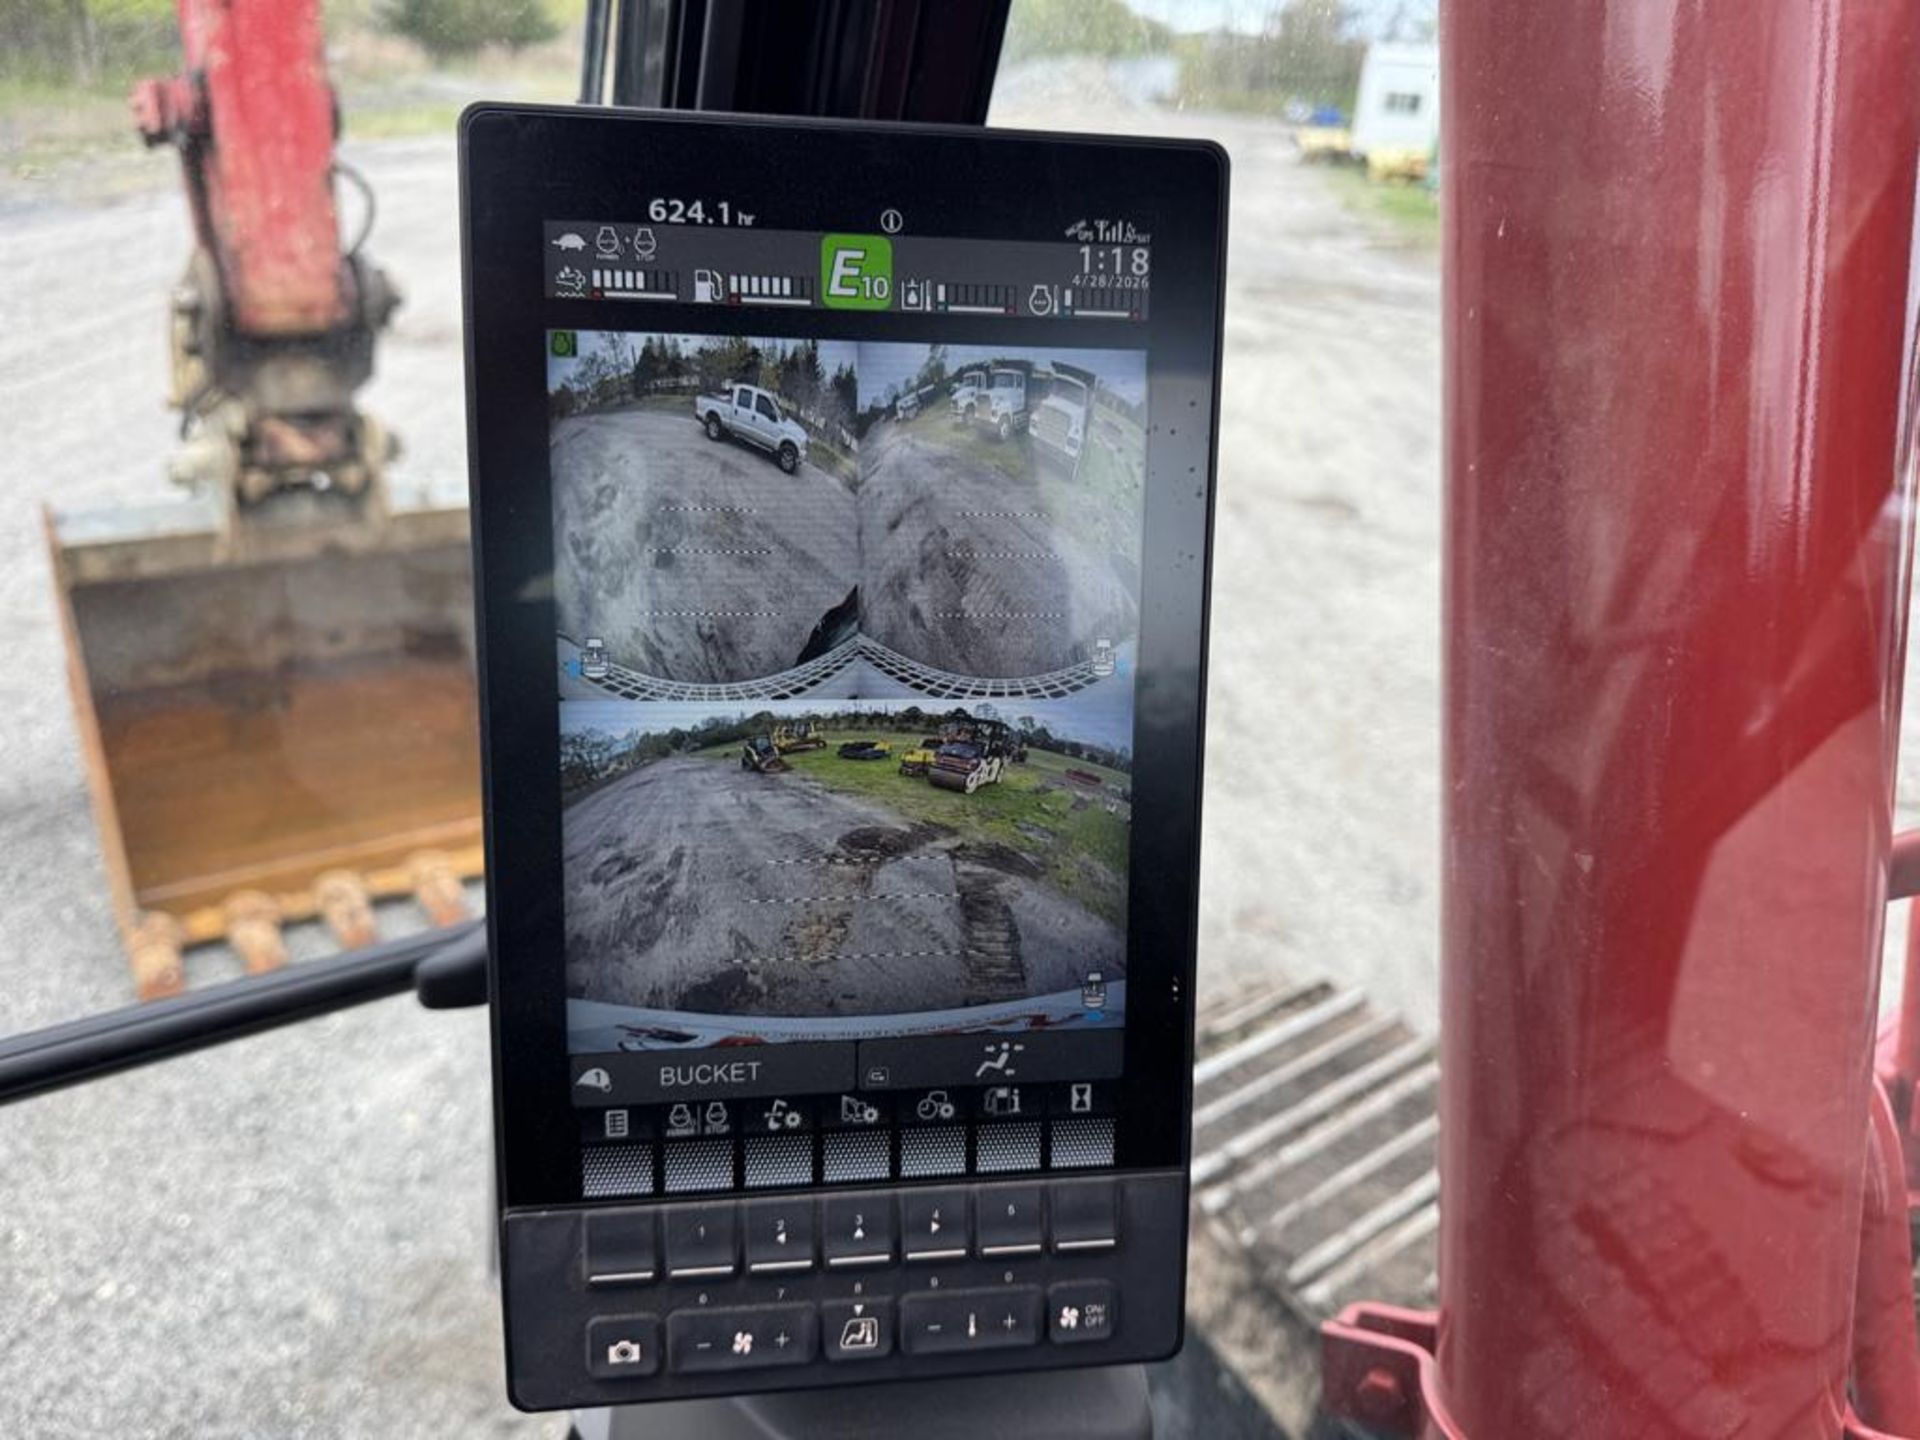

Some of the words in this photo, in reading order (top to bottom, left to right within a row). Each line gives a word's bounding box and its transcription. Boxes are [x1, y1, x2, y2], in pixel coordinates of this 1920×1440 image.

[648, 198, 731, 224] 624.1
[737, 211, 756, 226] hr
[1079, 245, 1150, 276] 1:18
[1071, 274, 1150, 290] 4/28/2026
[659, 1061, 763, 1087] BUCKET
[855, 1213, 864, 1226] 3
